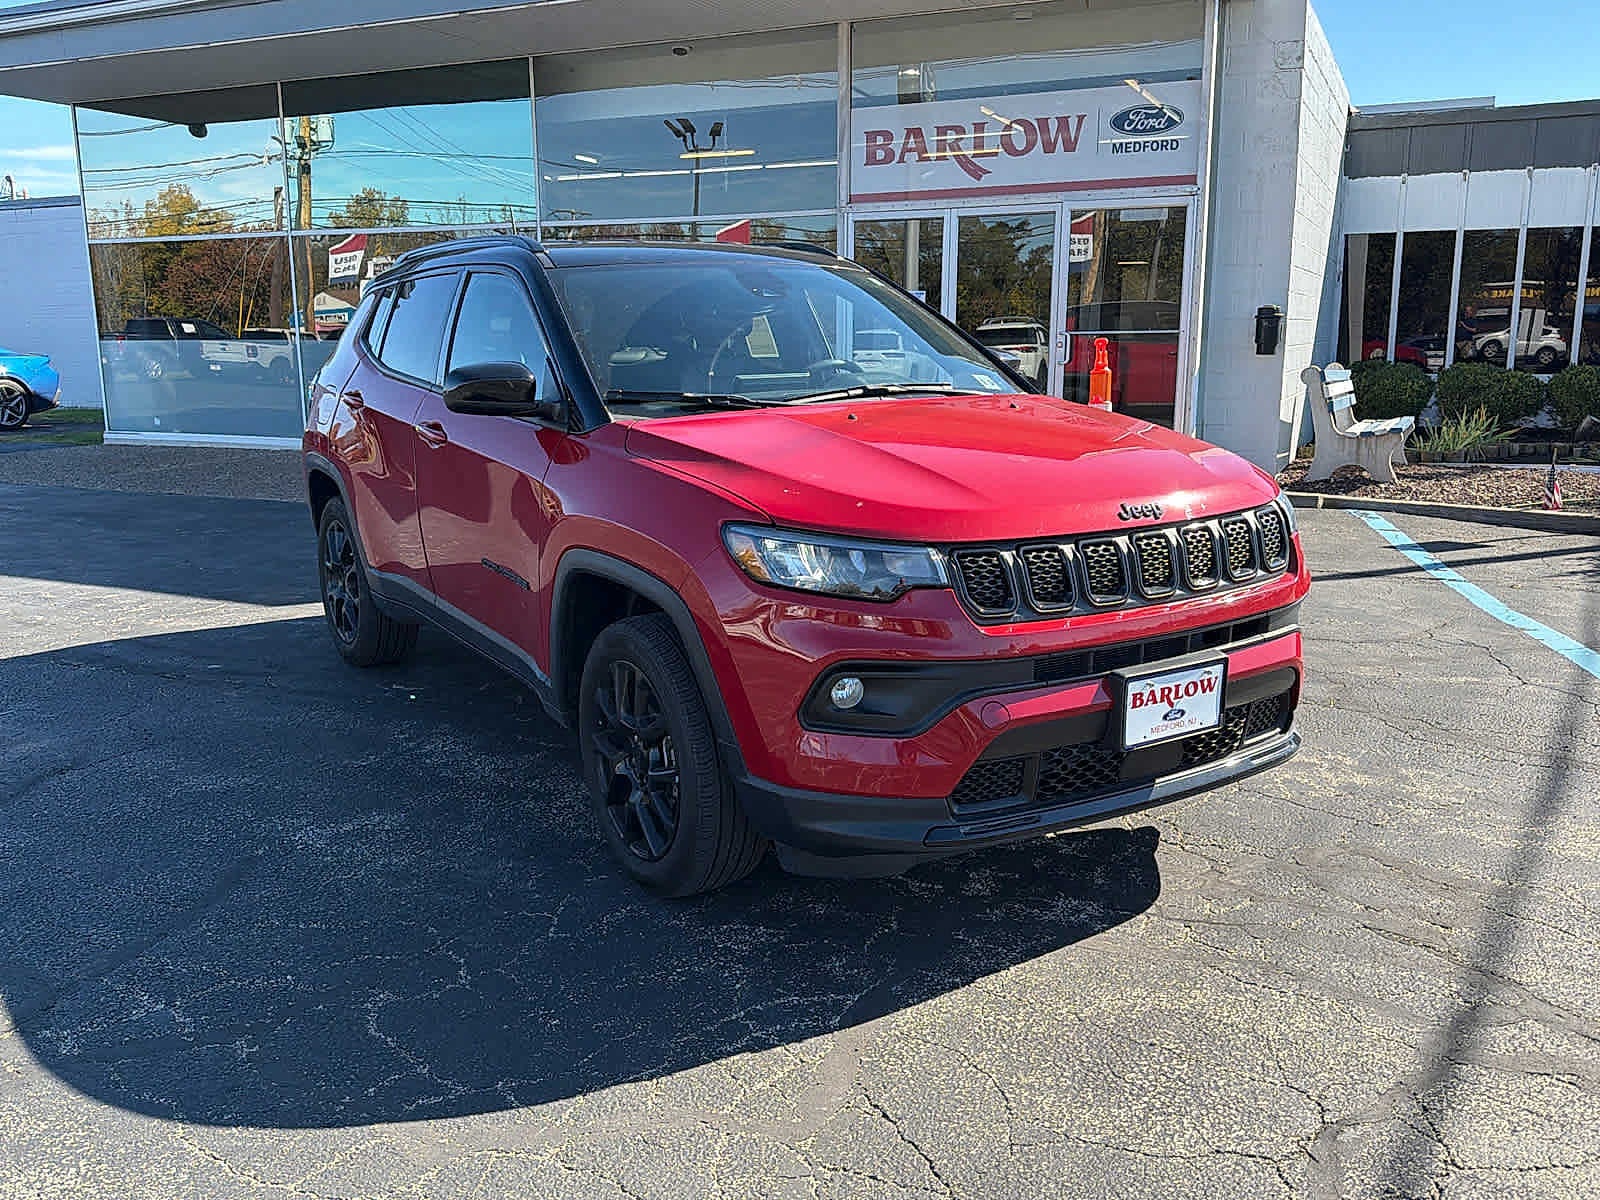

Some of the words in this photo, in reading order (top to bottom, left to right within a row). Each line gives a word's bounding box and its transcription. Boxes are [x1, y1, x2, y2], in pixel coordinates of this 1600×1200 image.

[1123, 110, 1170, 131] Ford
[864, 114, 1087, 182] BARLOW
[1112, 139, 1179, 154] MEDFORD
[1070, 237, 1089, 245] SED
[1117, 503, 1163, 521] Jeep
[1131, 676, 1218, 709] BARLOW
